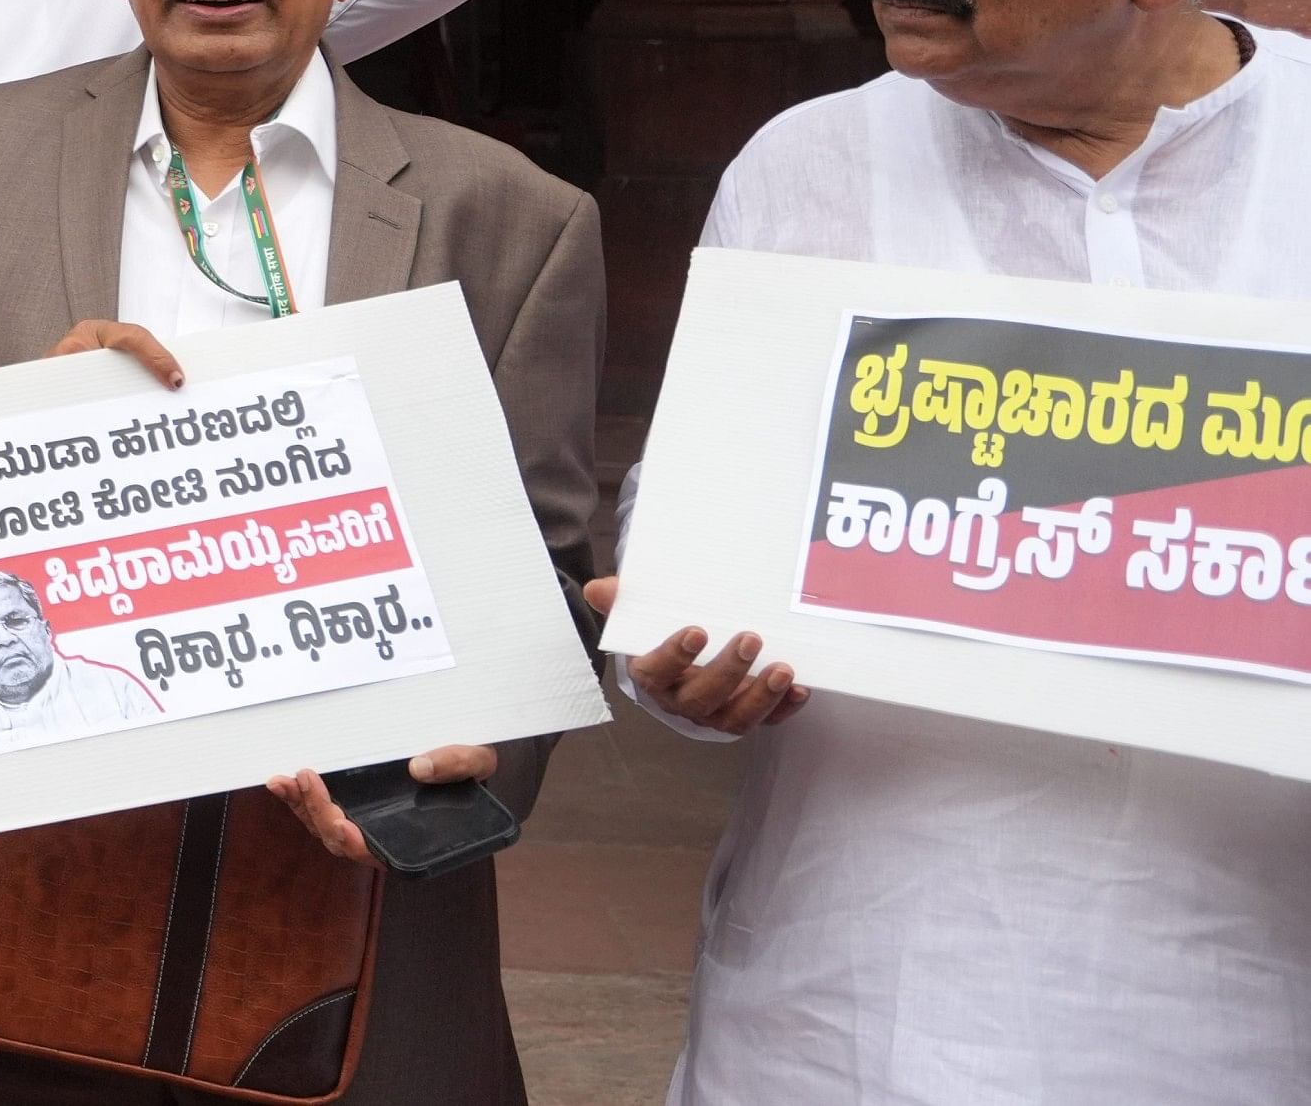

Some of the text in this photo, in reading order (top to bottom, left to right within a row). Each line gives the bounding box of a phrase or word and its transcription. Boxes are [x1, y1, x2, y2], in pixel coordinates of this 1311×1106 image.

[108, 390, 317, 457] ಹಗರಣದಲ್ಲಿ
[849, 343, 1189, 468] ಭ್ರಷ್ಟಾಚಾರದ
[93, 467, 208, 522] ಕೋಟಿ
[215, 438, 351, 500] ನುಂಗಿದ
[825, 476, 1114, 592] ಕಾಂಗ್ರೆಸ್
[134, 583, 433, 692] ಧಿಕ್ಕಾರ.. ಧಿಕ್ಕಾರ..
